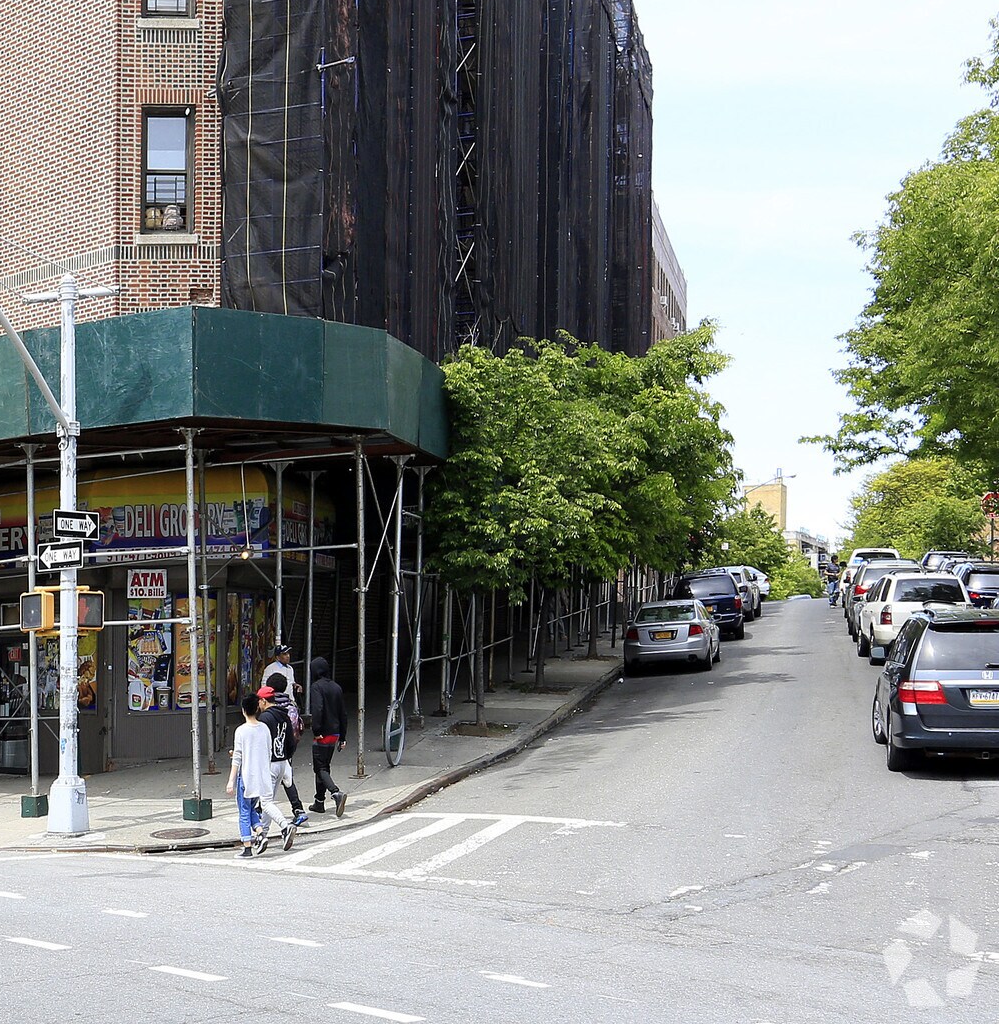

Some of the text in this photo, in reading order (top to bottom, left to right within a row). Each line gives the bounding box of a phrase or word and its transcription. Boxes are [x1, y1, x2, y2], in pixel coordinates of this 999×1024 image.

[61, 519, 92, 531] ONE WAY
[125, 503, 225, 537] DELI GROCRY
[44, 549, 77, 563] ONE WAY
[131, 573, 164, 587] ATM
